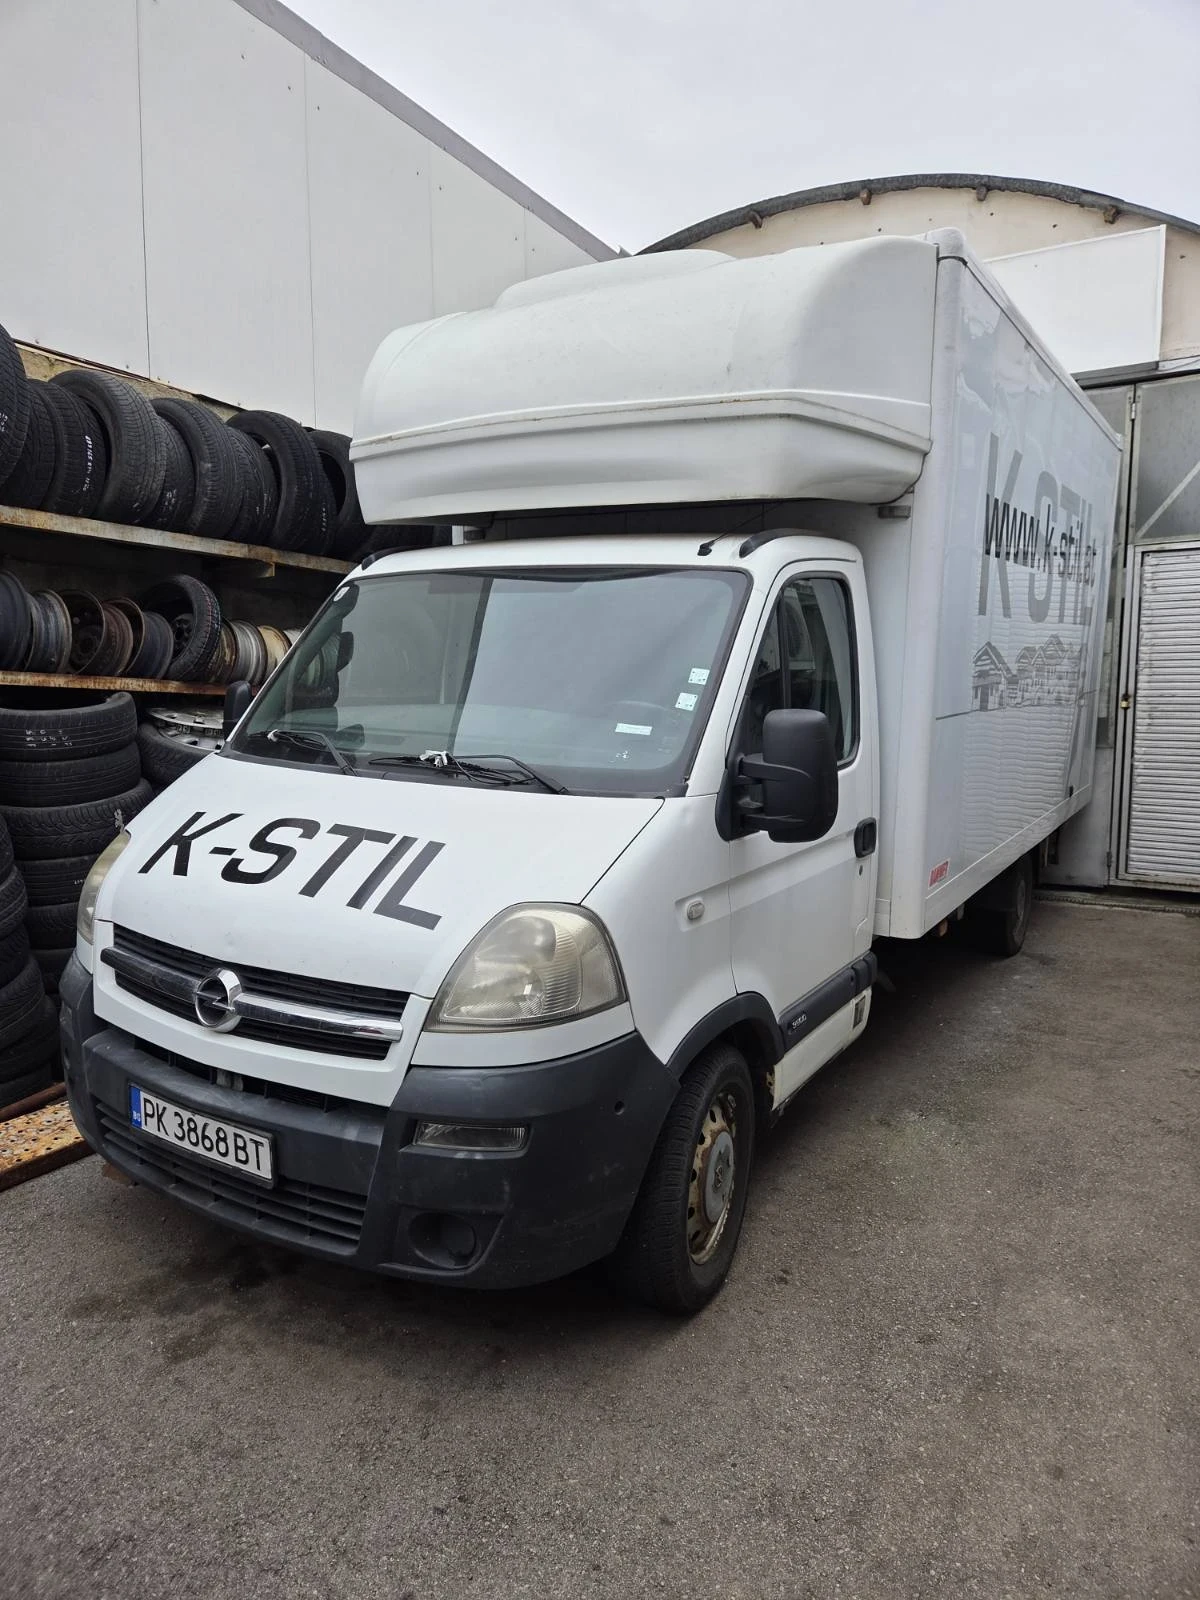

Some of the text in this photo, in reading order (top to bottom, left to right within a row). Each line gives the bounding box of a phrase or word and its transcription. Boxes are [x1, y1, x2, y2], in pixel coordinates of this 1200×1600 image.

[985, 493, 1097, 588] www.k-stil.at
[137, 811, 447, 931] K-STIL
[143, 1098, 265, 1171] PK 3868 BT
